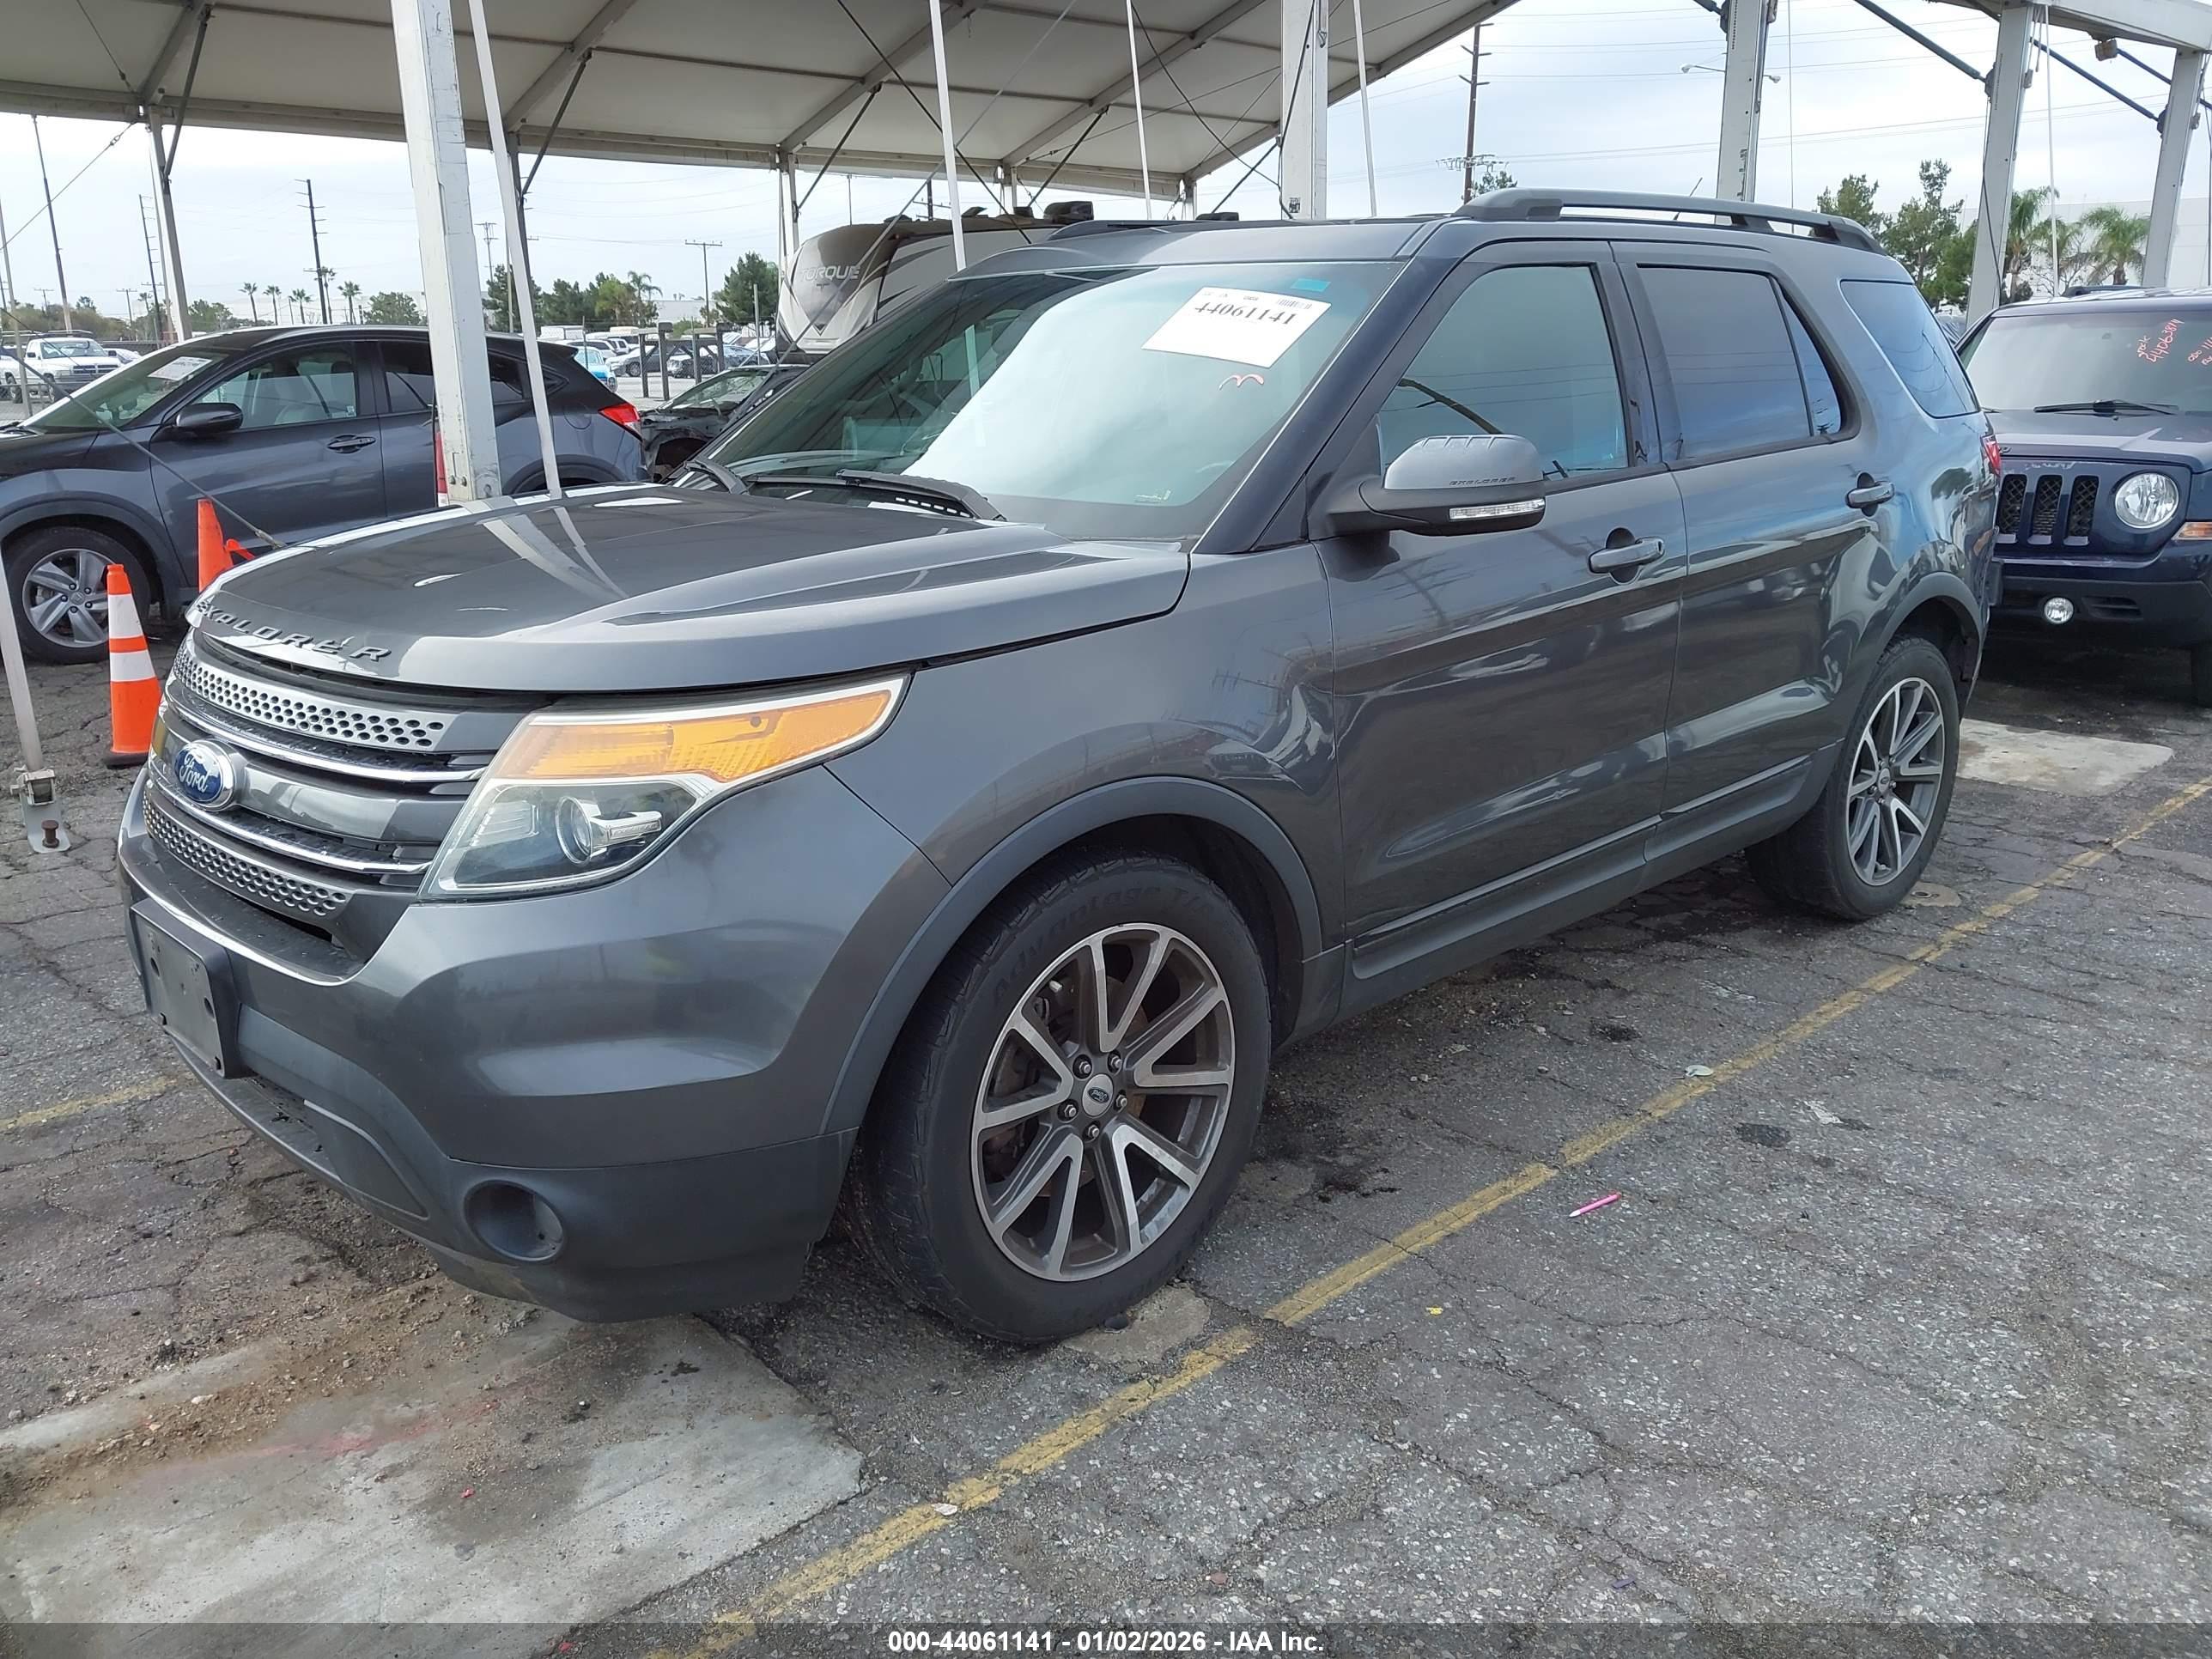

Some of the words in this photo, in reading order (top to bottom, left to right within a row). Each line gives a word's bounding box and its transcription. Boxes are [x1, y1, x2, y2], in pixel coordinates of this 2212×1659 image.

[802, 264, 861, 281] TORQUE
[1194, 301, 1297, 325] 44061141
[196, 599, 392, 662] EXPLORER
[179, 752, 210, 793] Ford
